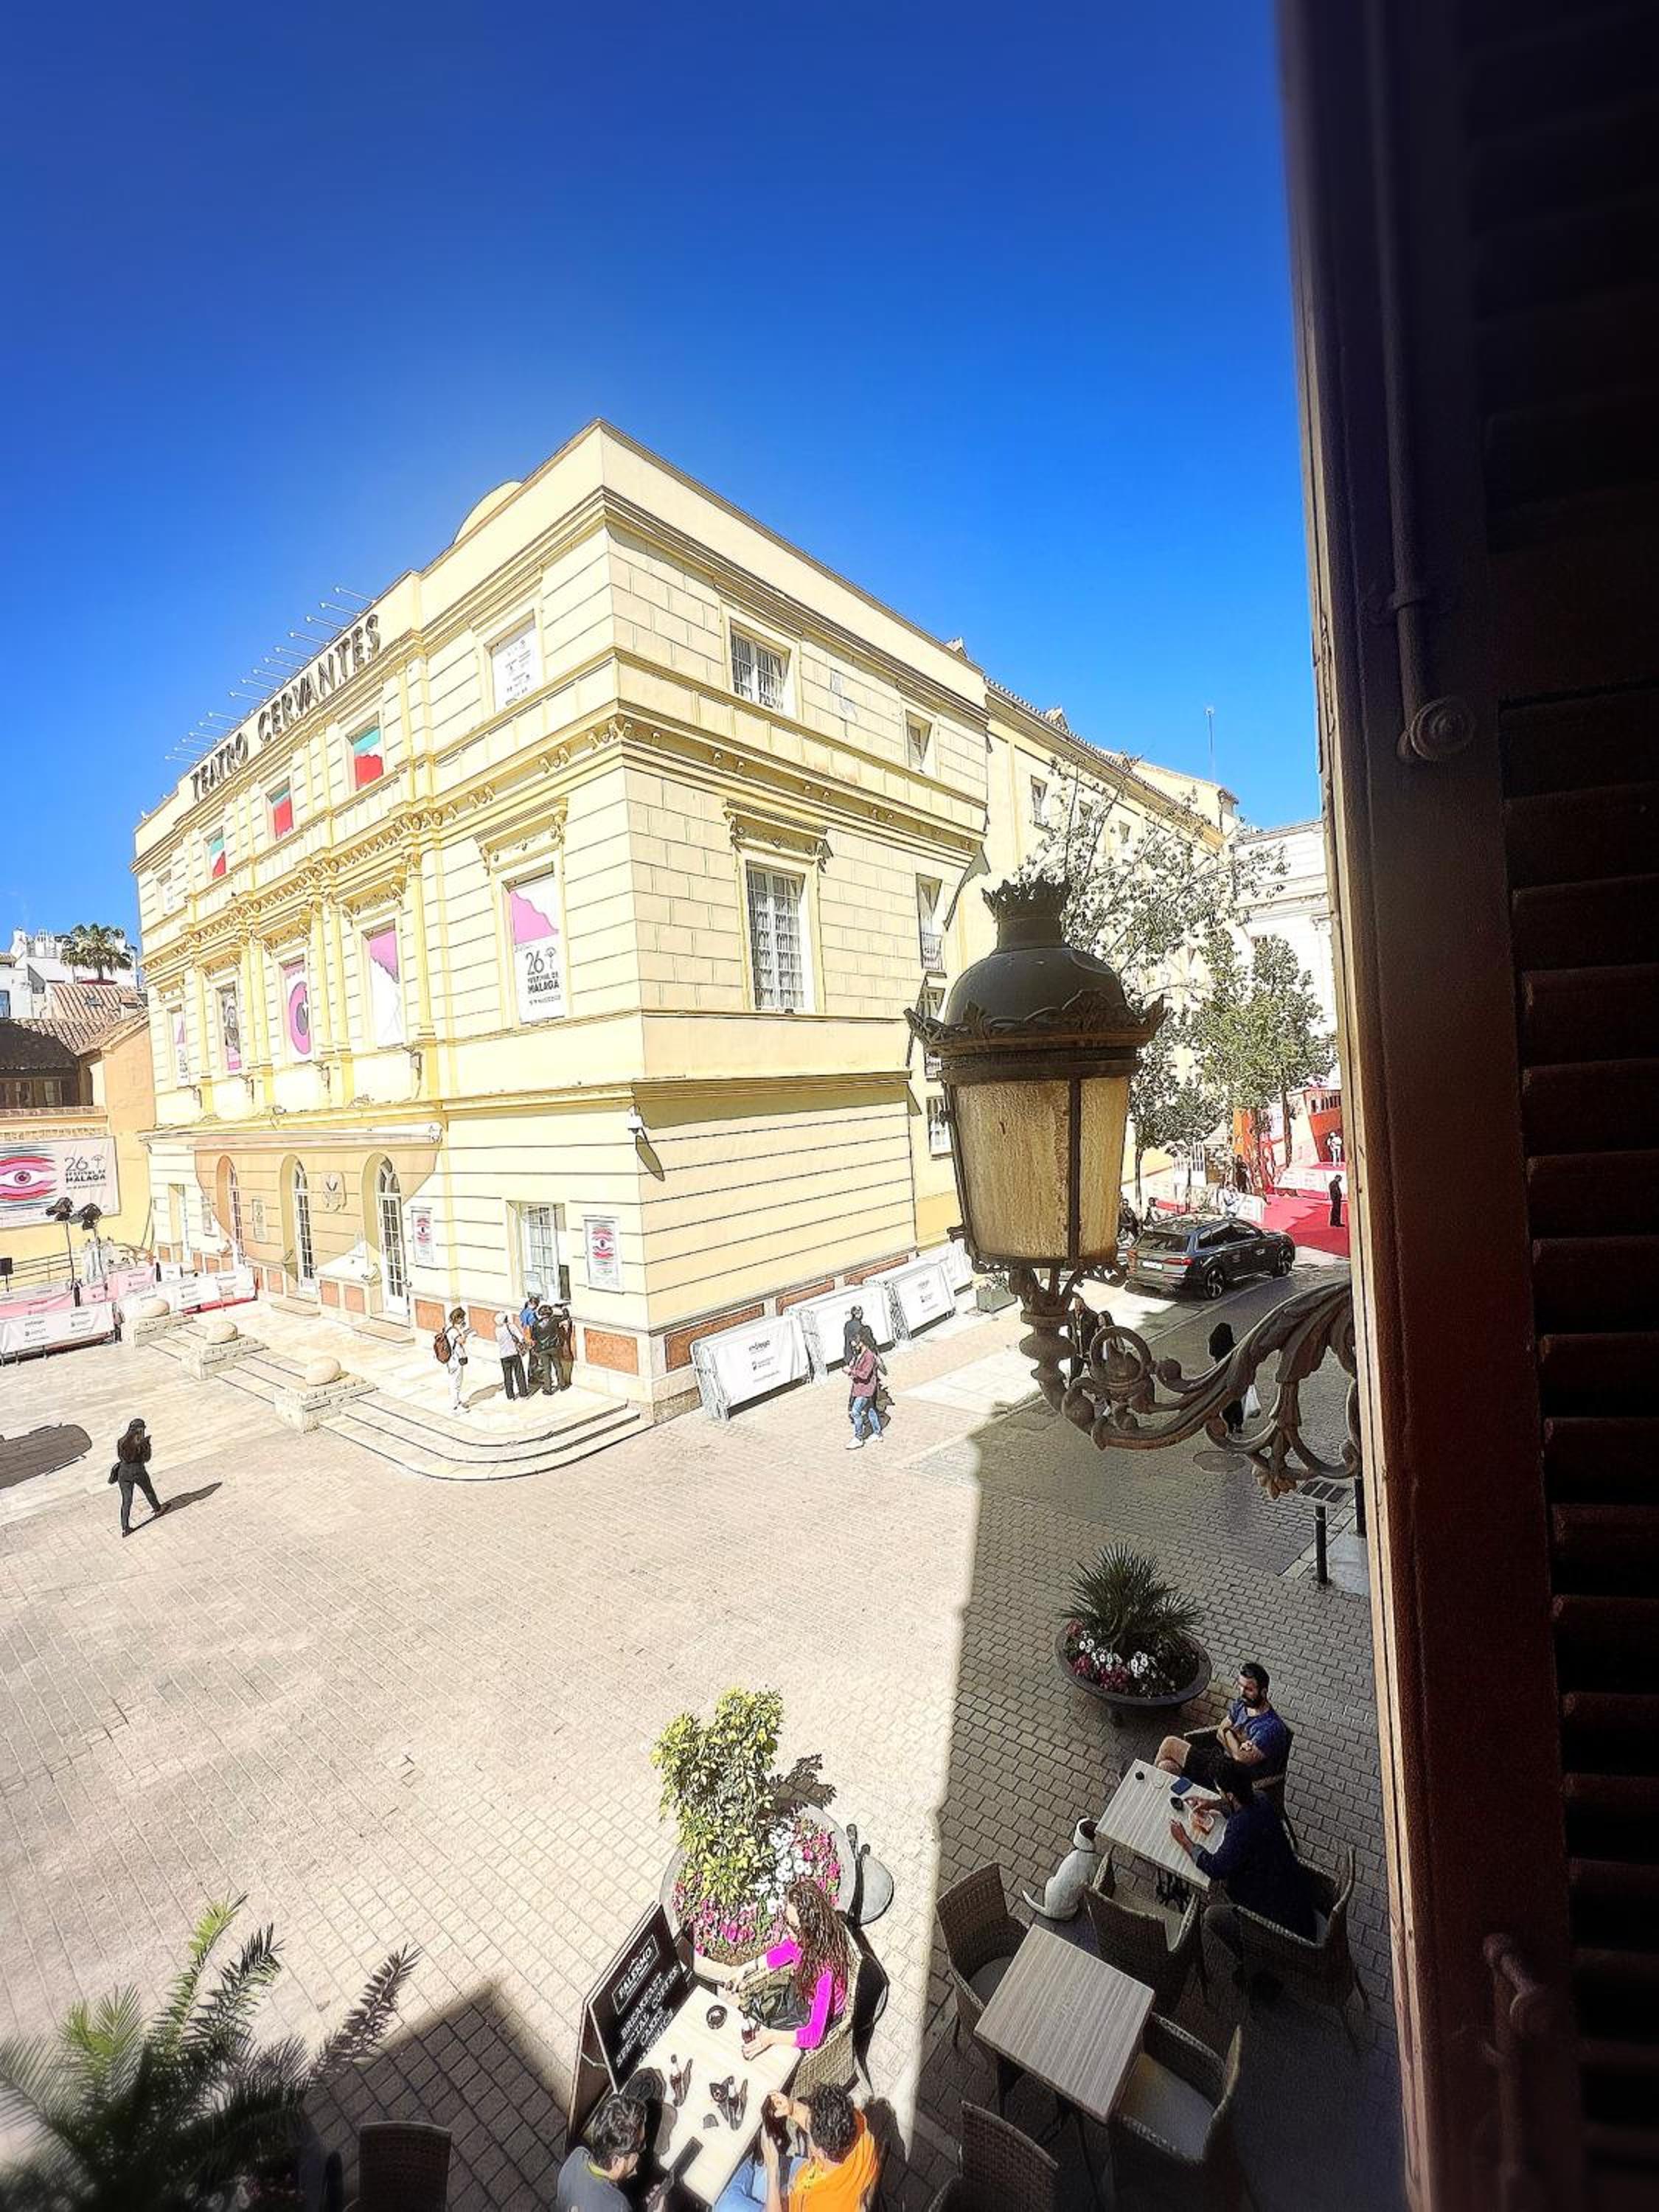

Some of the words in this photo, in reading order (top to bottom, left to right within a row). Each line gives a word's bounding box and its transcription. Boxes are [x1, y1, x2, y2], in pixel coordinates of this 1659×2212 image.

[189, 731, 249, 803] TEATRO
[257, 613, 382, 745] CERVANTES
[525, 950, 545, 975] 26
[64, 1155, 89, 1172] 26
[619, 1945, 653, 1999] PALERMO
[620, 1972, 662, 2039] BREAKFAST
[640, 2006, 664, 2047] CAKES
[616, 2012, 650, 2069] SPECIAL
